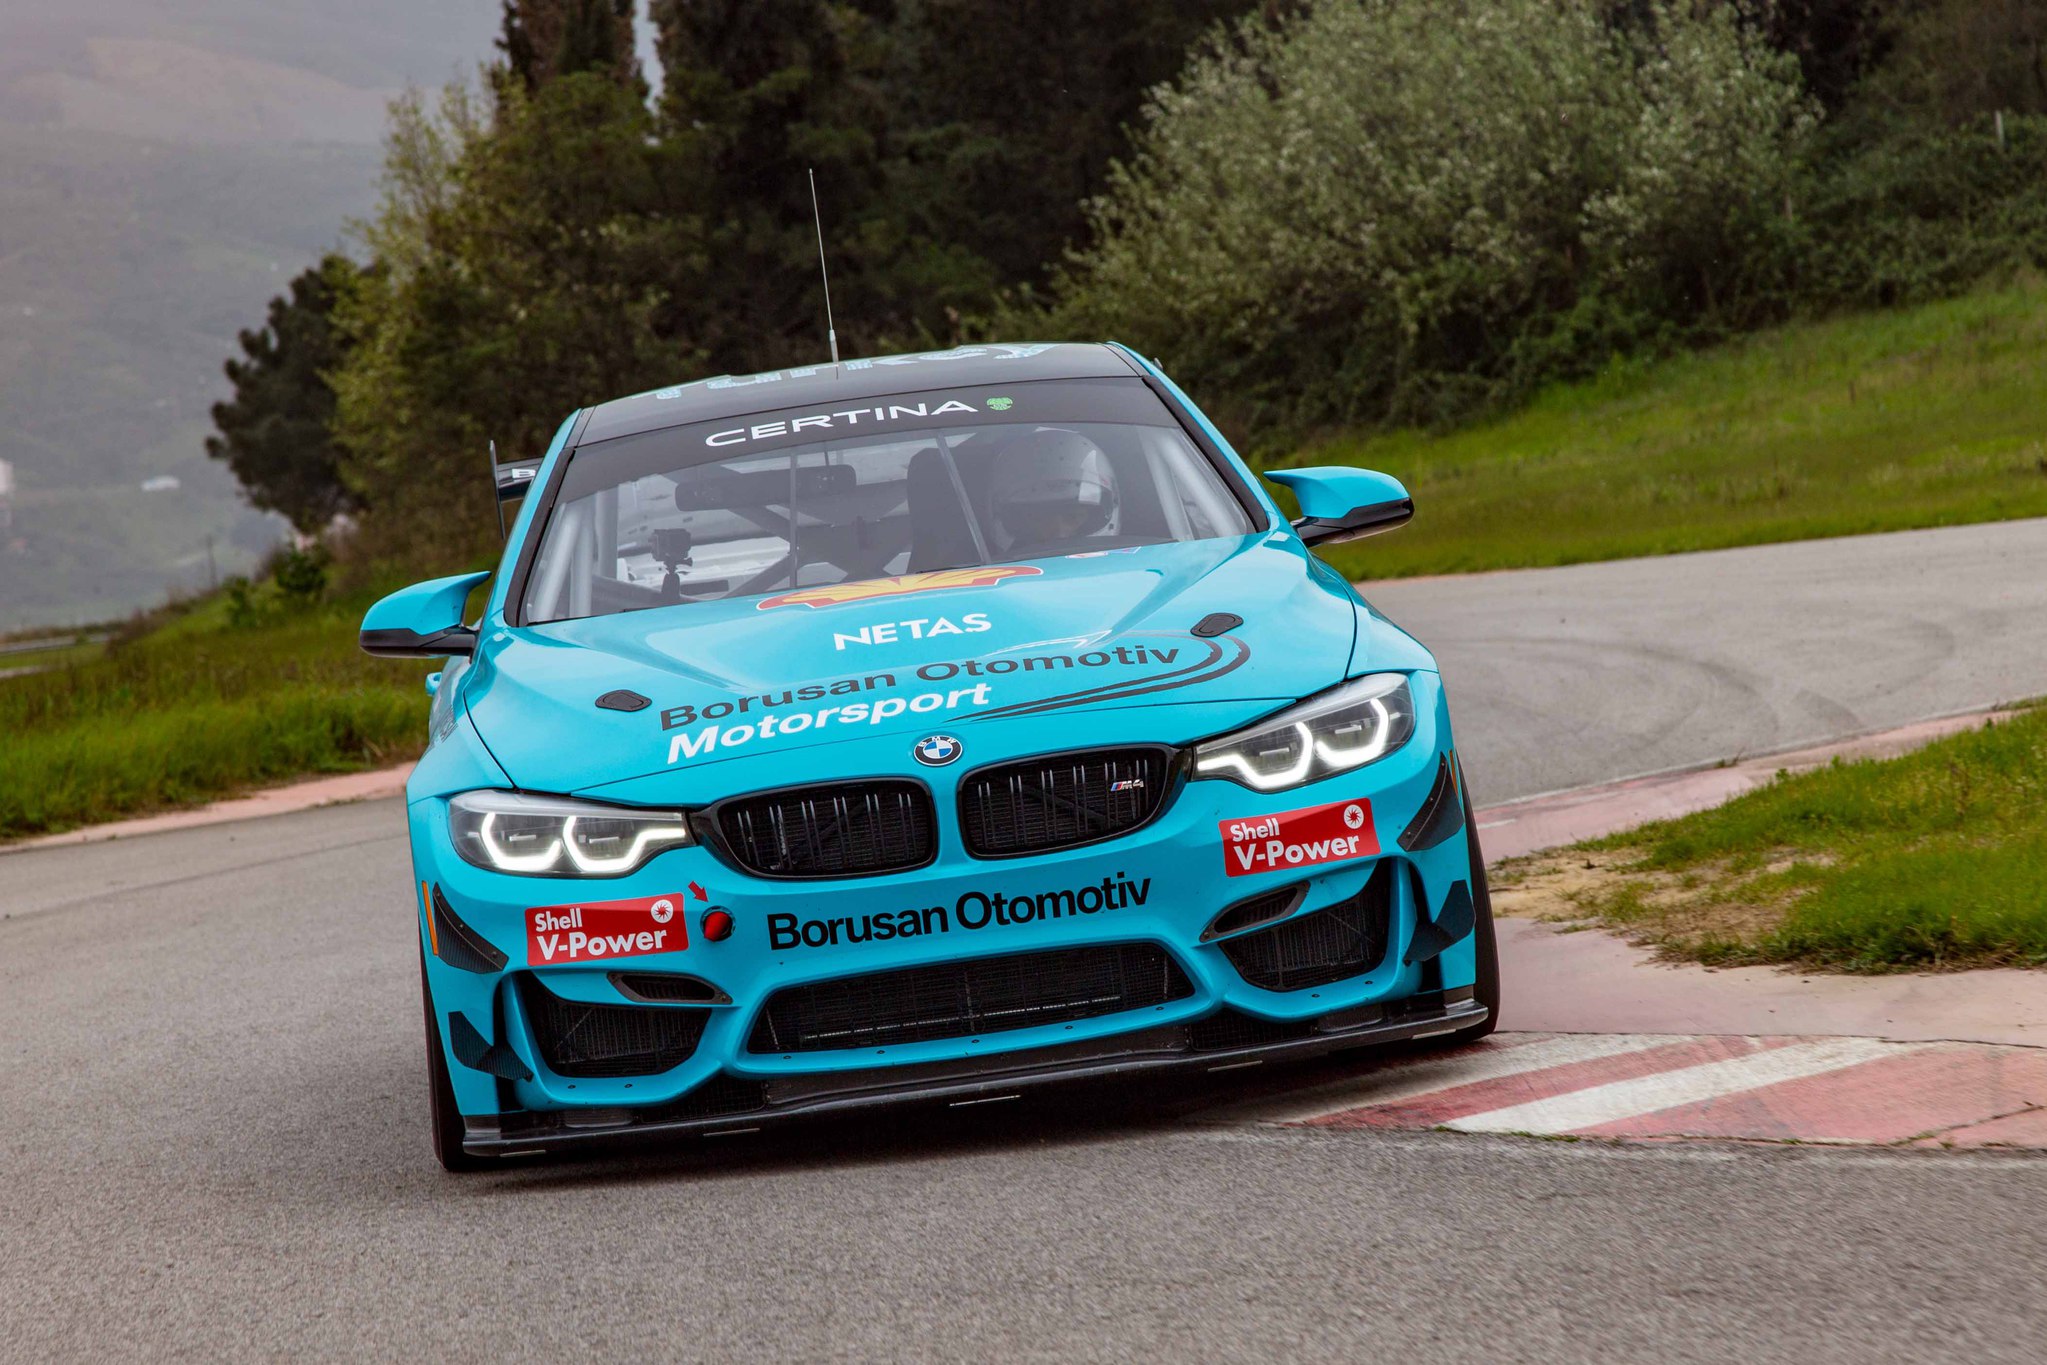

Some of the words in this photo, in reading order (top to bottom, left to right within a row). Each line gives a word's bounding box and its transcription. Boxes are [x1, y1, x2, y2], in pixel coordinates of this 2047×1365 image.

[705, 399, 978, 447] CERTINA
[833, 613, 992, 651] NETAS
[659, 674, 896, 731] Borusan
[917, 644, 1180, 682] Otomotiv
[666, 683, 993, 765] Motorsport
[1230, 817, 1280, 842] Shell
[1234, 834, 1361, 871] V-Power
[534, 908, 583, 932] Shell
[767, 907, 949, 950] Borusan
[956, 872, 1150, 928] Otomotiv
[536, 926, 668, 961] V-Power
